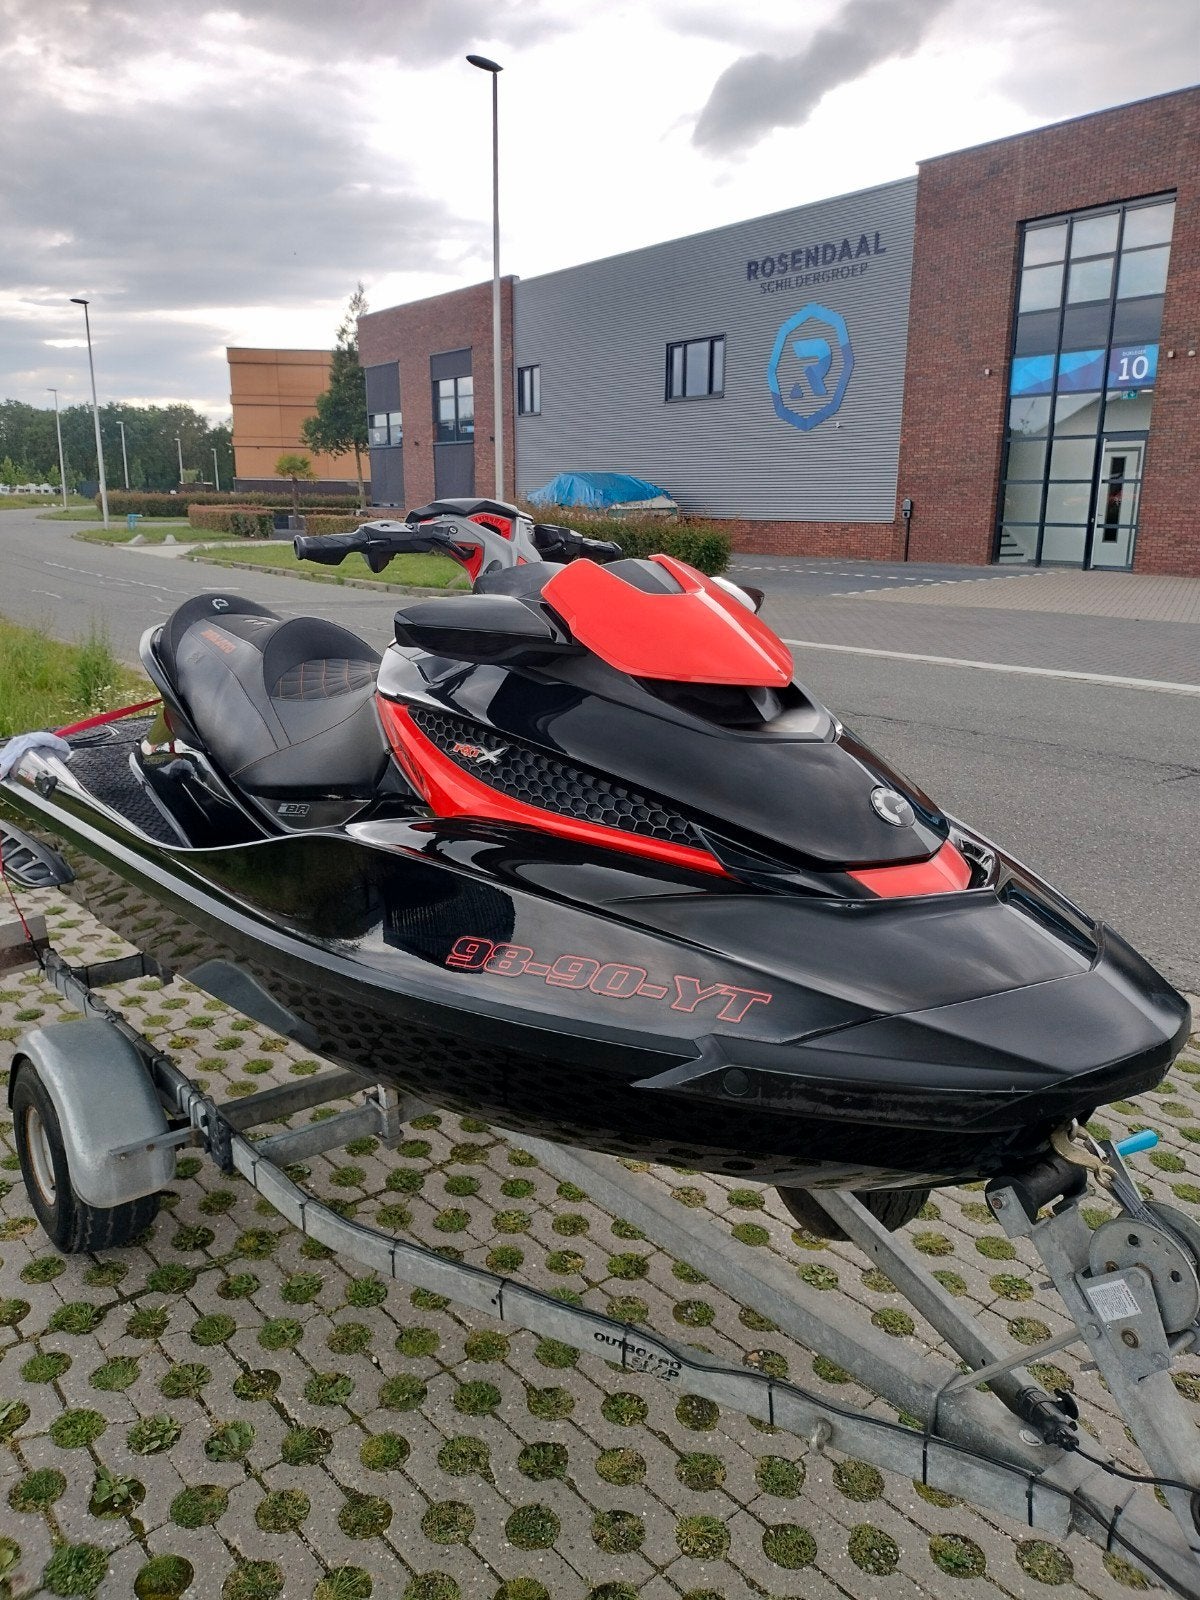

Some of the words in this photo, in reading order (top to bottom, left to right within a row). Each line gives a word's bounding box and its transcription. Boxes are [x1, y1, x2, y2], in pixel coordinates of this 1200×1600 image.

[746, 231, 886, 281] ROSENDAAL
[760, 262, 870, 294] SCHILDERGROEP
[1118, 356, 1148, 380] 10
[446, 936, 772, 1023] 98-90-YT
